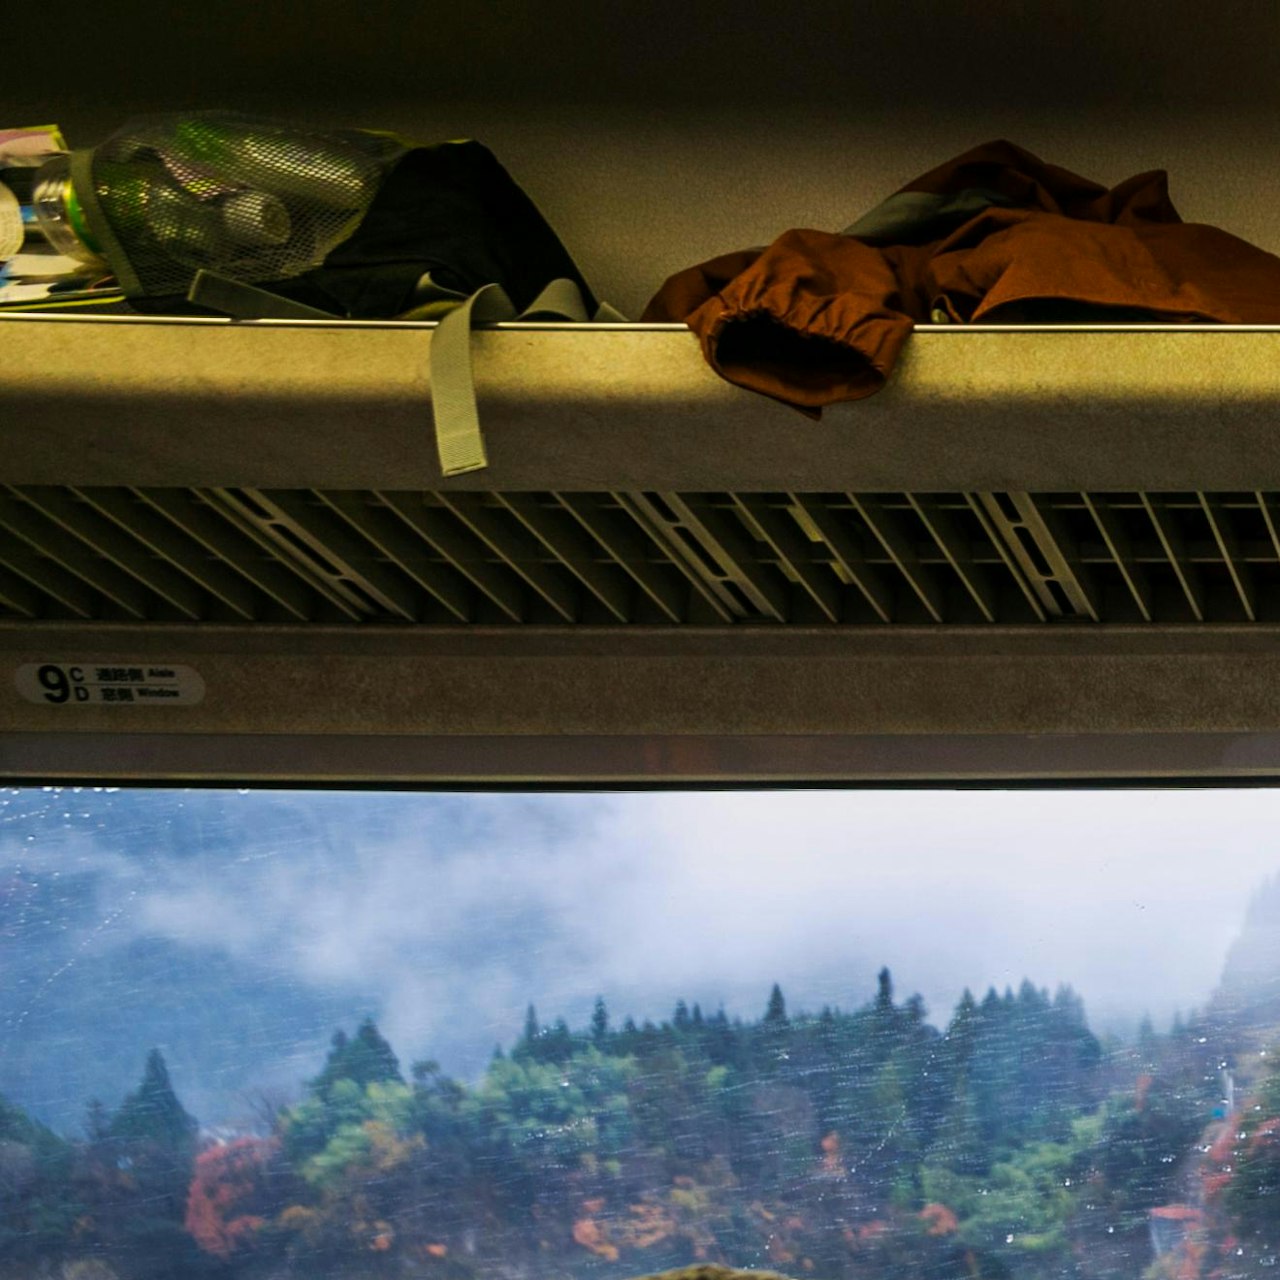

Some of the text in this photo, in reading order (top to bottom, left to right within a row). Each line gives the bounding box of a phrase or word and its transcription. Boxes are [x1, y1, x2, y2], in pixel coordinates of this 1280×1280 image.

[69, 667, 84, 682] C
[38, 665, 70, 703] 9
[75, 686, 89, 701] D
